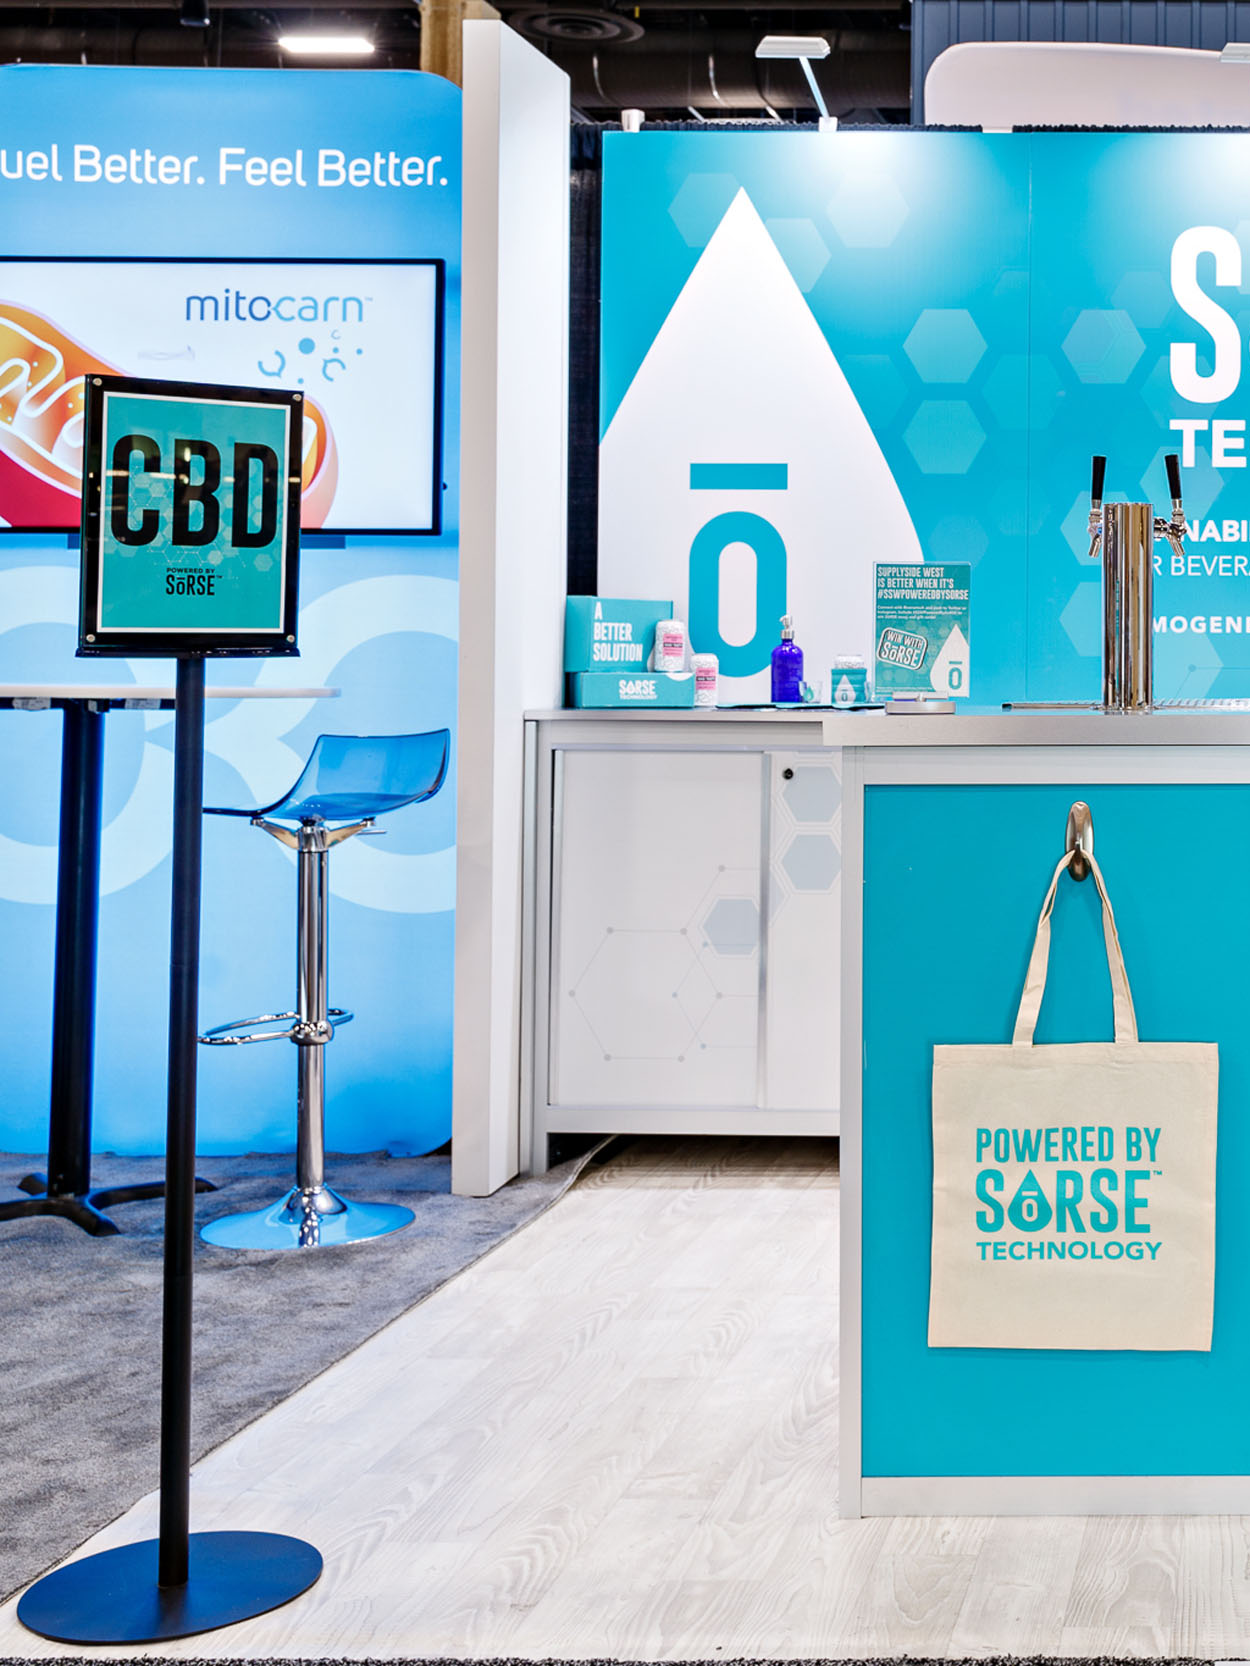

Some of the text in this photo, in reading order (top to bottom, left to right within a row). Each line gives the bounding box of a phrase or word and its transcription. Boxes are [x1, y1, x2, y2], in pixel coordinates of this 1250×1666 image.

[0, 144, 448, 187] uel Better. Feel Better.
[186, 288, 363, 322] mitocarn
[110, 434, 278, 548] CBD
[877, 566, 944, 577] SUPPLYSIDE WEST
[878, 578, 885, 588] IS
[887, 578, 914, 588] BETTER
[915, 578, 938, 589] WHEN
[594, 601, 603, 620] A
[593, 622, 632, 641] BETTER
[886, 631, 923, 649] WIN WITH
[593, 643, 643, 662] SOLUTION
[976, 1126, 1162, 1163] POWERED BY
[976, 1241, 1163, 1261] TECHNOLOGY
